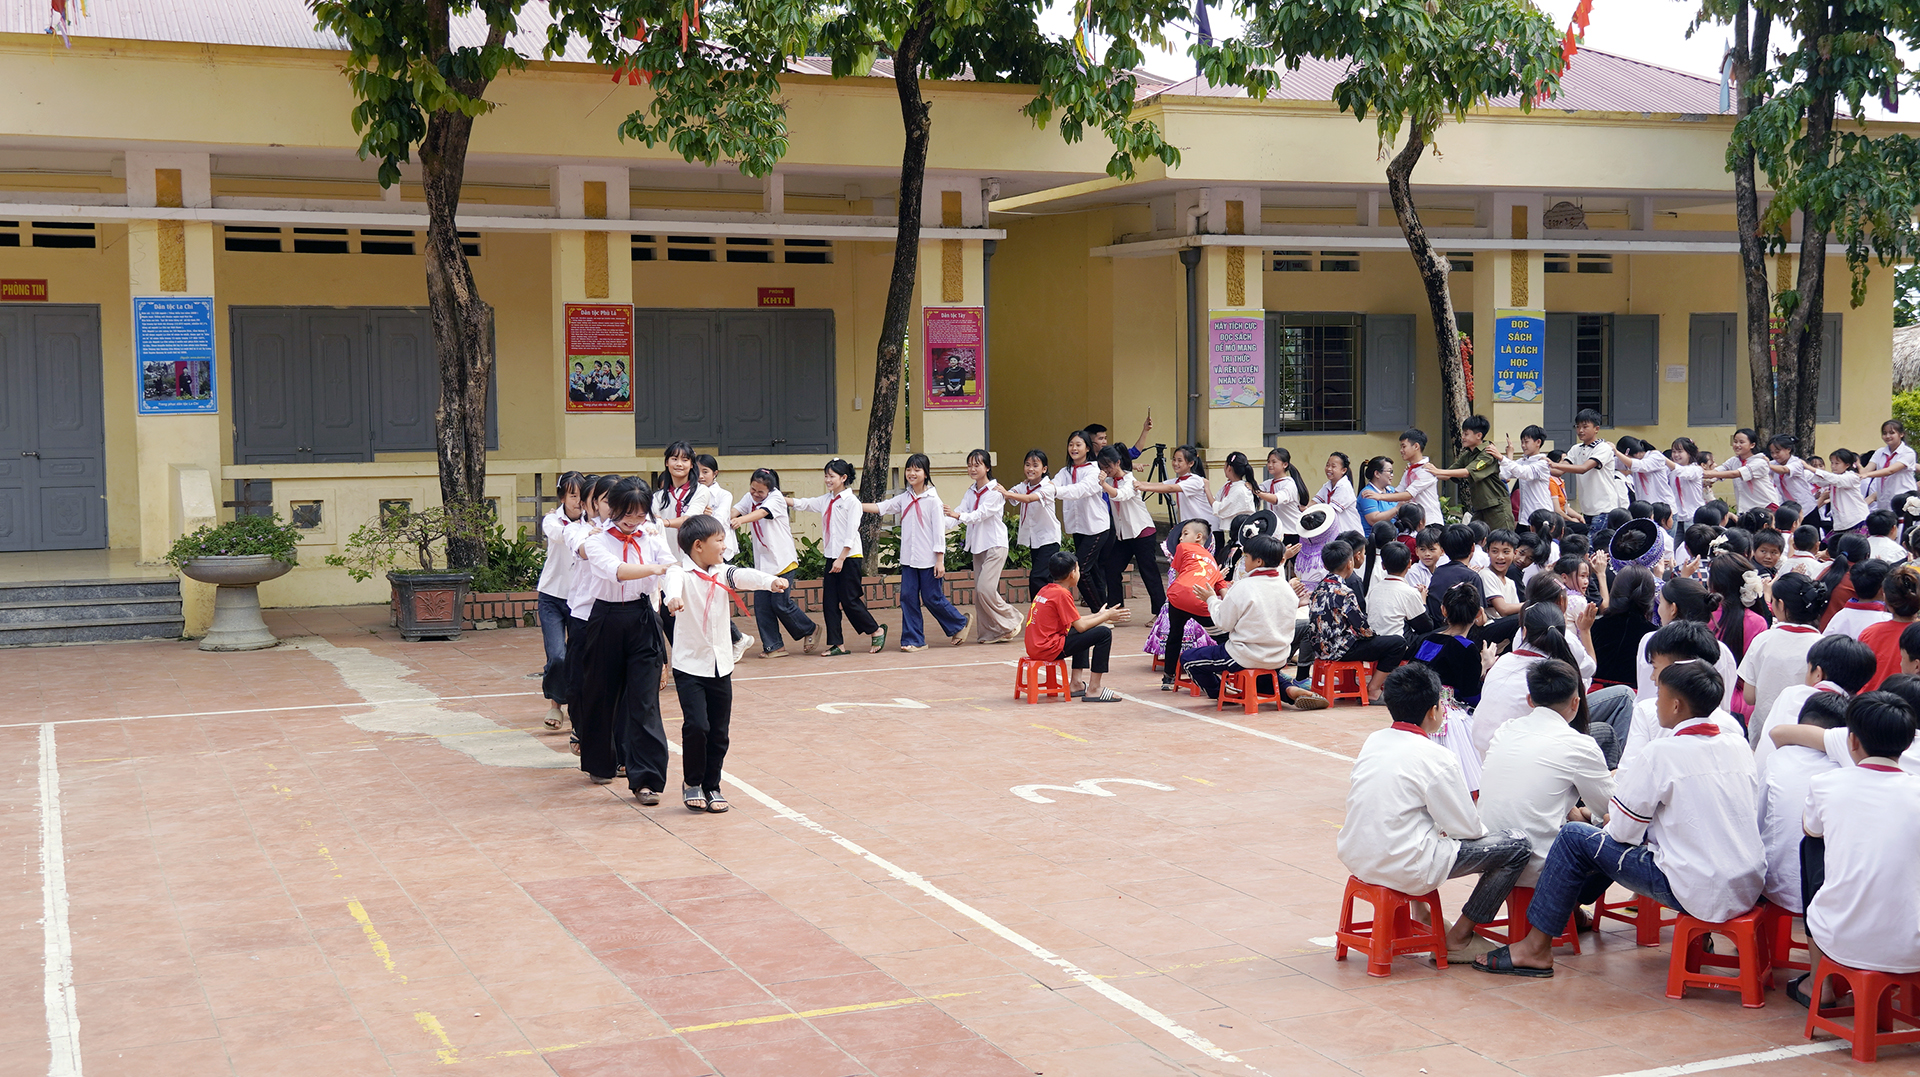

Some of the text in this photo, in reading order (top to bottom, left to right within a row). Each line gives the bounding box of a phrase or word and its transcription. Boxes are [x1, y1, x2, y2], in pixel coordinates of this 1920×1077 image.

[3, 281, 45, 295] PHÒNG TIN
[1229, 321, 1243, 330] TÍCH
[1244, 322, 1258, 331] CỰC
[1511, 320, 1530, 330] ĐỌC
[1220, 332, 1252, 342] ĐỌC SÁCH
[1508, 332, 1532, 341] SÁCH
[1225, 343, 1236, 352] MỞ
[1501, 344, 1538, 354] LÀ CÁCH
[1234, 353, 1251, 363] THỨC
[1510, 358, 1528, 368] HỌC
[1213, 365, 1223, 373] VÀ
[1238, 365, 1259, 375] LUYỆN
[1498, 368, 1540, 379] TỐT NHẤT
[1218, 375, 1255, 385] NHÂN CÁCH
